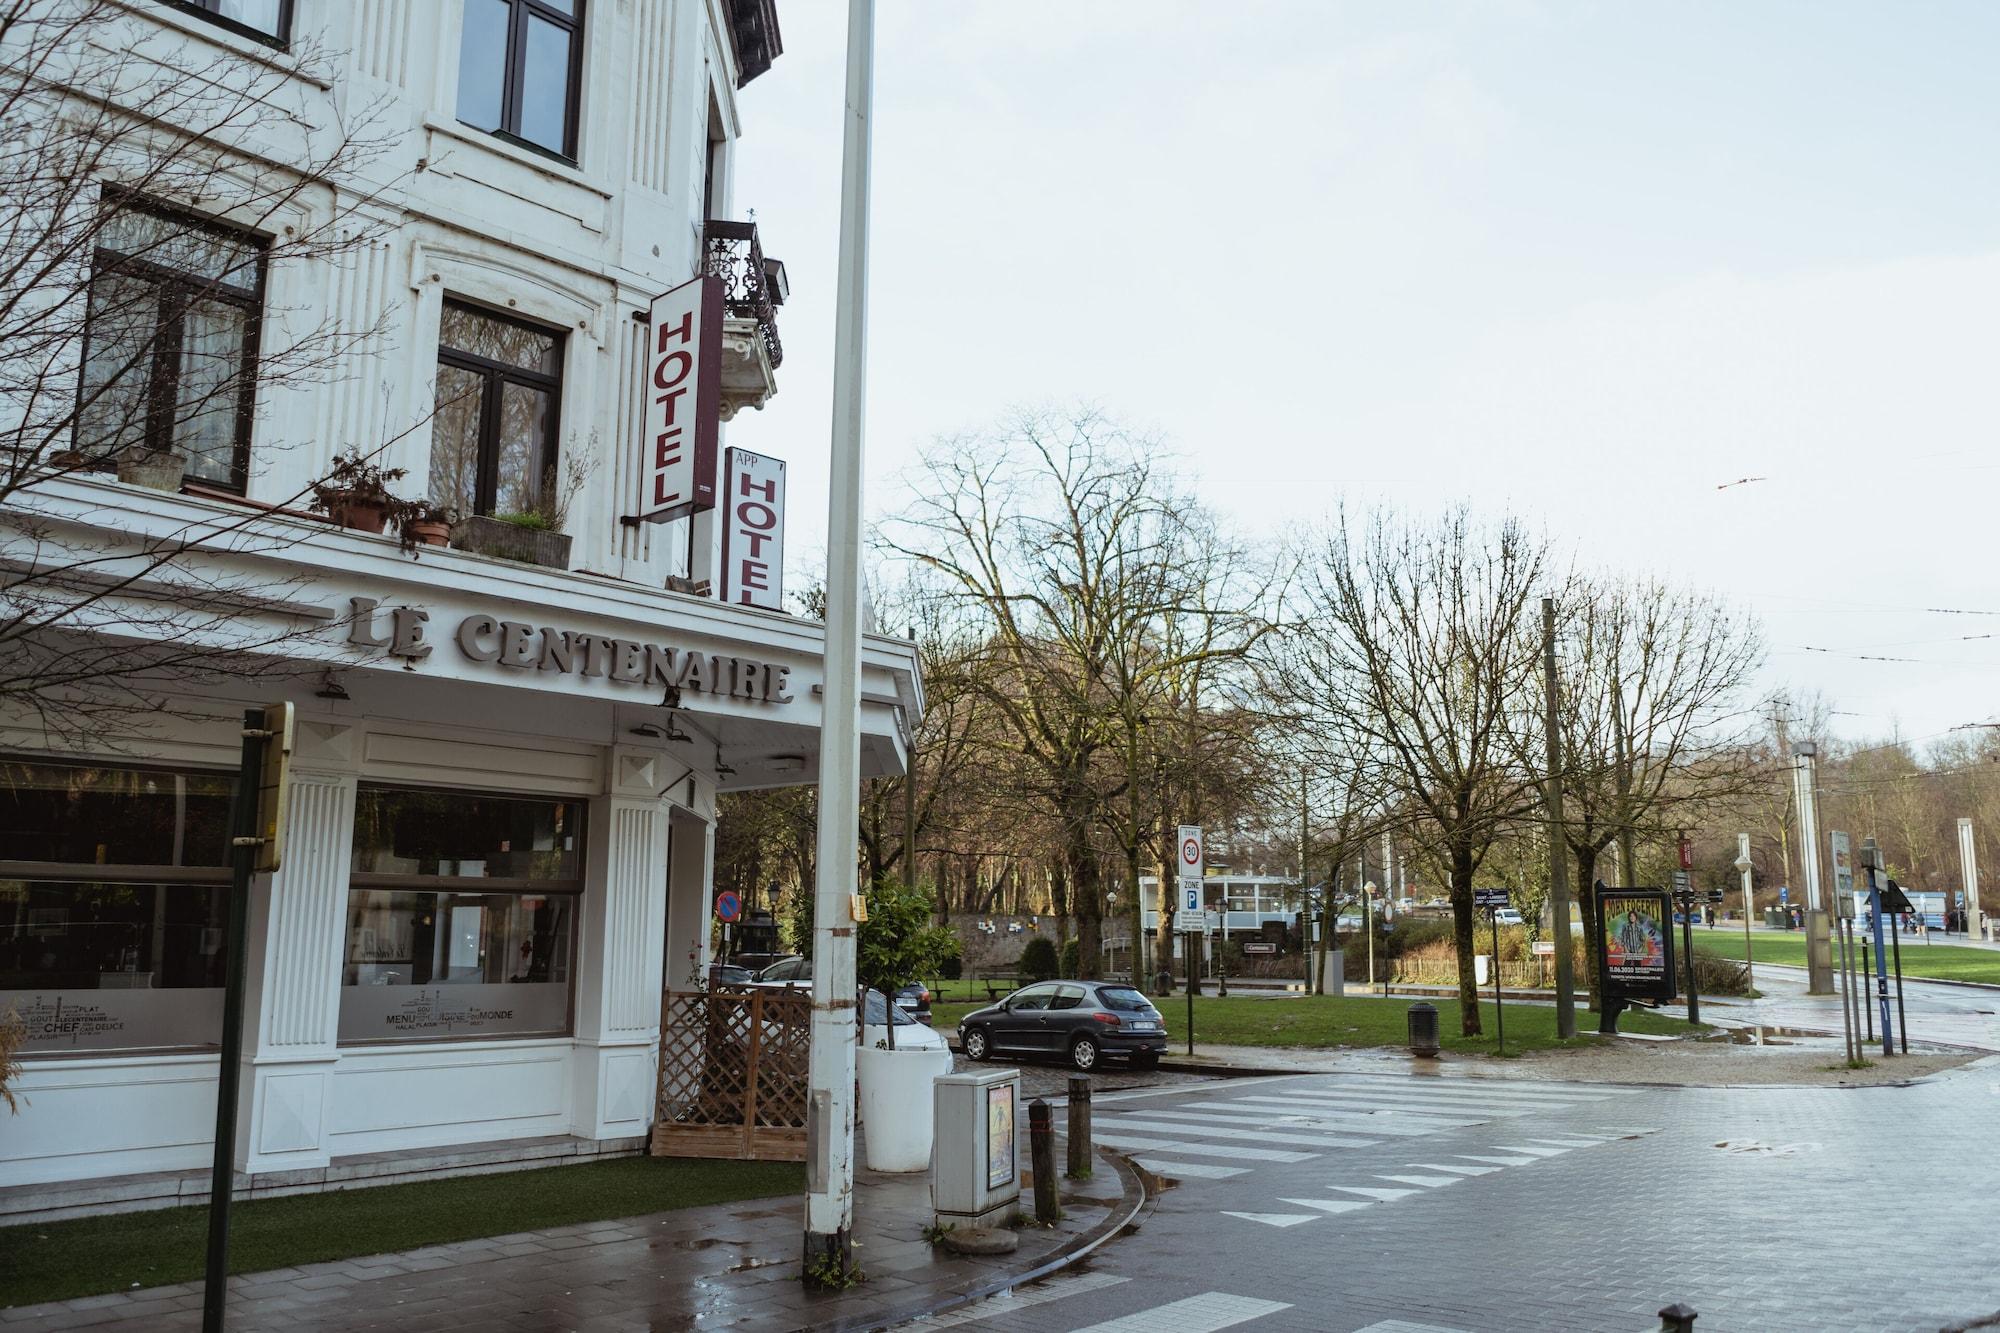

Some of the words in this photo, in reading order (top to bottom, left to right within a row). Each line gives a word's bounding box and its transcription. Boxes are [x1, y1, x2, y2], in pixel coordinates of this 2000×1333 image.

[654, 311, 693, 506] HOTEL
[348, 596, 432, 658] LE
[455, 614, 795, 704] CENTENAIRE
[1186, 846, 1196, 857] 30
[1184, 881, 1200, 889] ZONE
[386, 1014, 416, 1025] MENU
[479, 1010, 513, 1020] MONDE
[43, 1023, 80, 1033] CHEF
